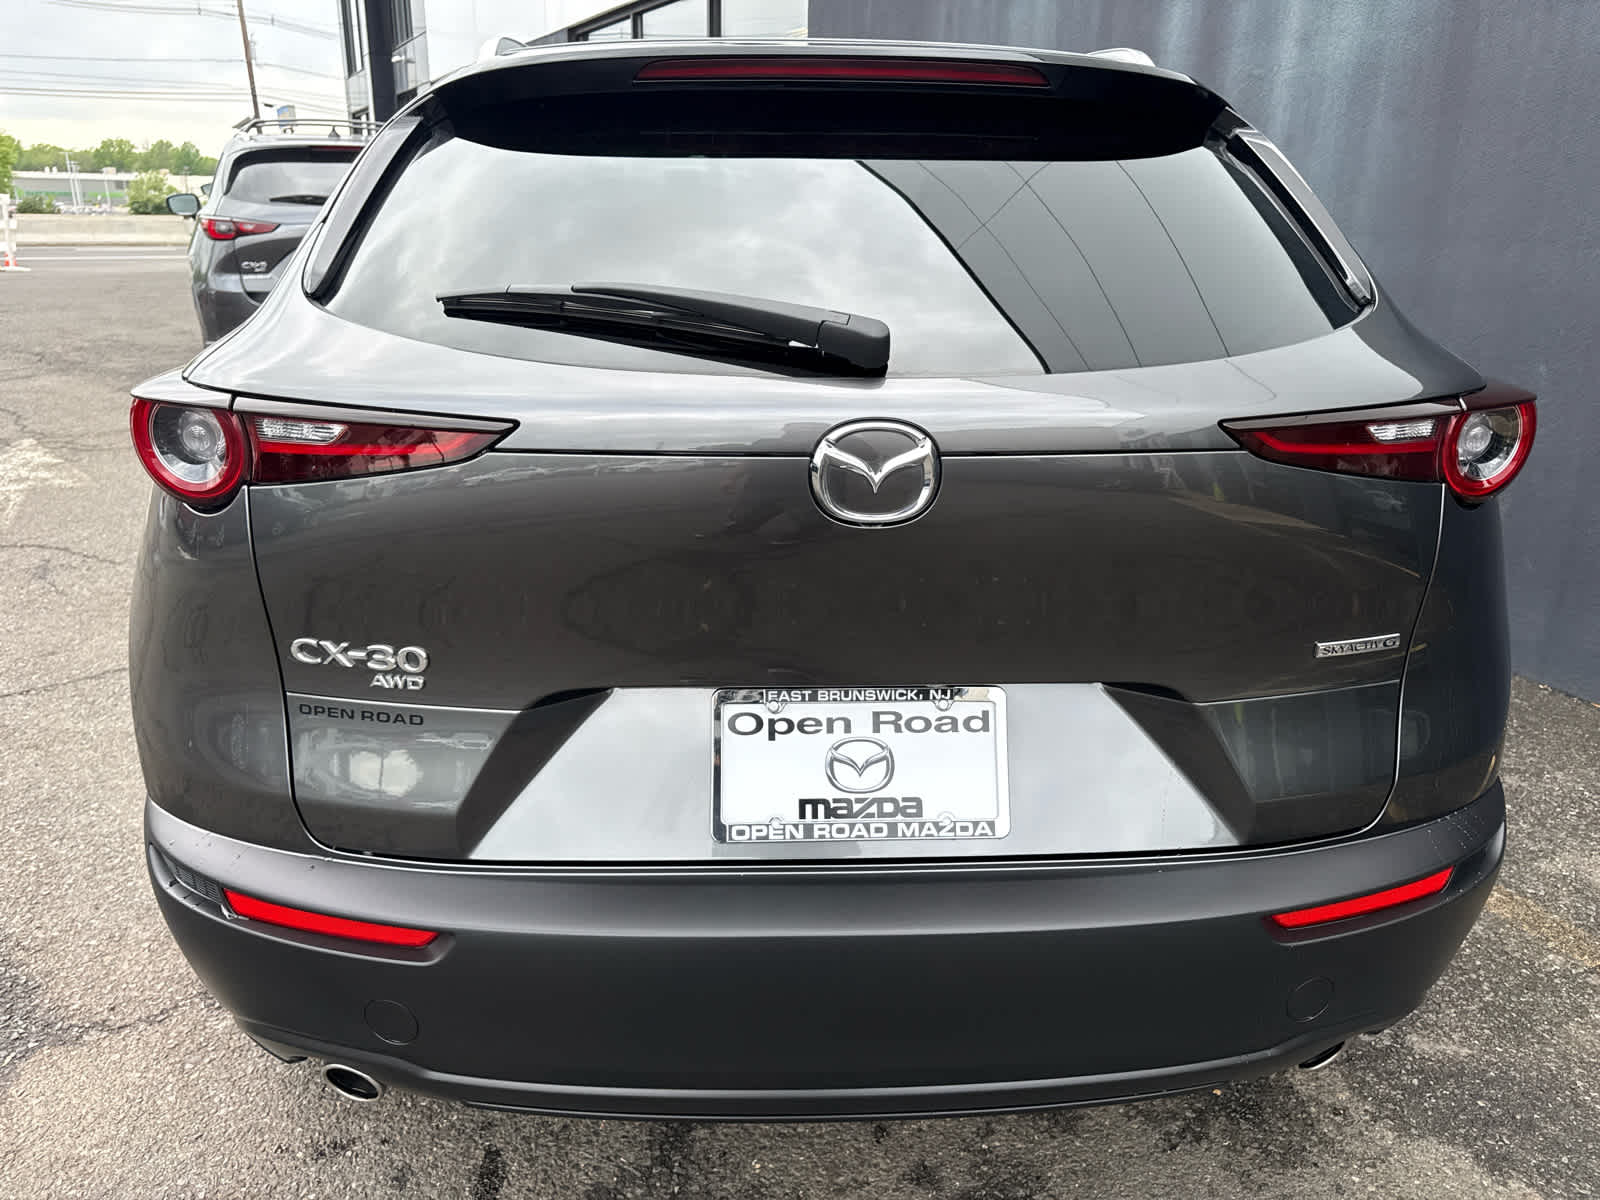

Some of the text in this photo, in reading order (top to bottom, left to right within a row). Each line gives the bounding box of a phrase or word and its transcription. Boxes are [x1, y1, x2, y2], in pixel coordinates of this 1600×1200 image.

[290, 637, 428, 673] CX-30
[370, 673, 425, 690] AWD
[767, 688, 952, 702] EAST BRUNSWICK, NJ
[299, 703, 424, 726] OPEN ROAD
[727, 710, 990, 741] Open Road
[731, 822, 994, 840] OPEN ROAD MAZDA
